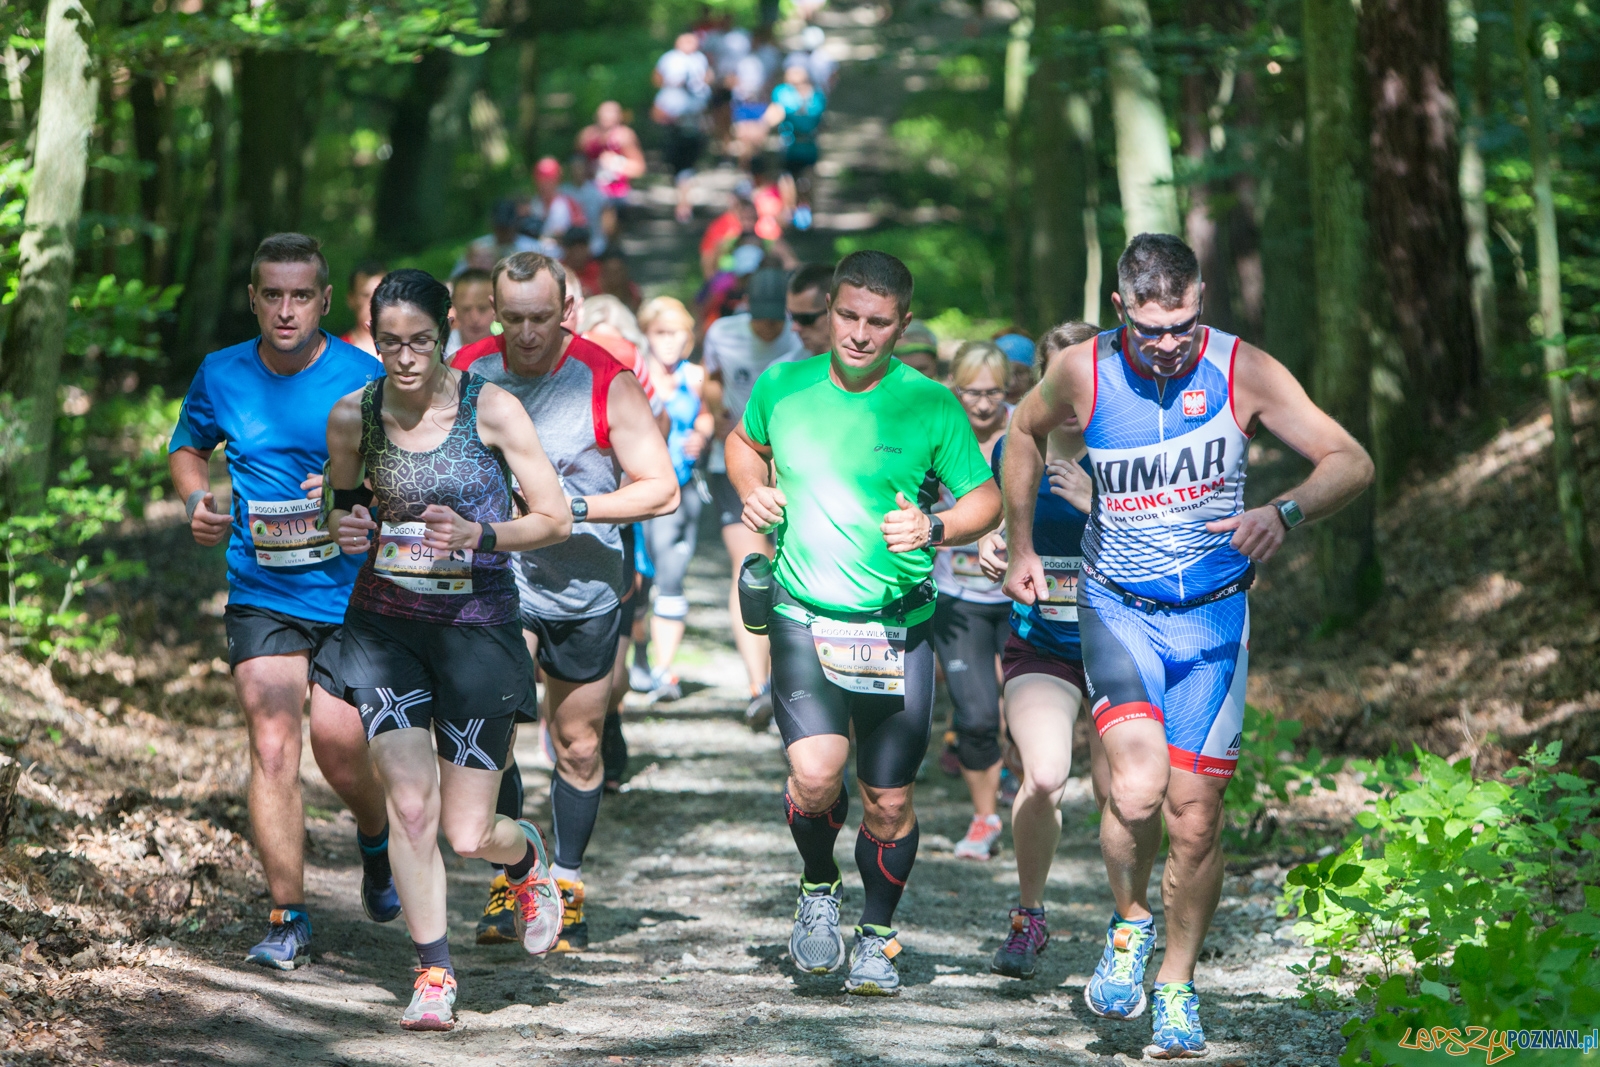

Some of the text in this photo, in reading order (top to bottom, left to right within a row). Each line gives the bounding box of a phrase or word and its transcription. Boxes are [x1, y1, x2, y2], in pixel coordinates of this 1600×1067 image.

[883, 445, 903, 454] asics
[1106, 477, 1225, 512] RACING TEAM
[254, 502, 318, 514] POGOŃ ZA WILKIE
[1129, 513, 1159, 522] YOUR
[271, 518, 307, 538] 310
[389, 526, 416, 535] POGOŃ
[410, 542, 435, 562] 94
[1044, 560, 1072, 569] POGOŃ
[866, 630, 900, 639] WILKIEM
[848, 643, 872, 662] 10
[1101, 712, 1147, 733] RACING TEAM
